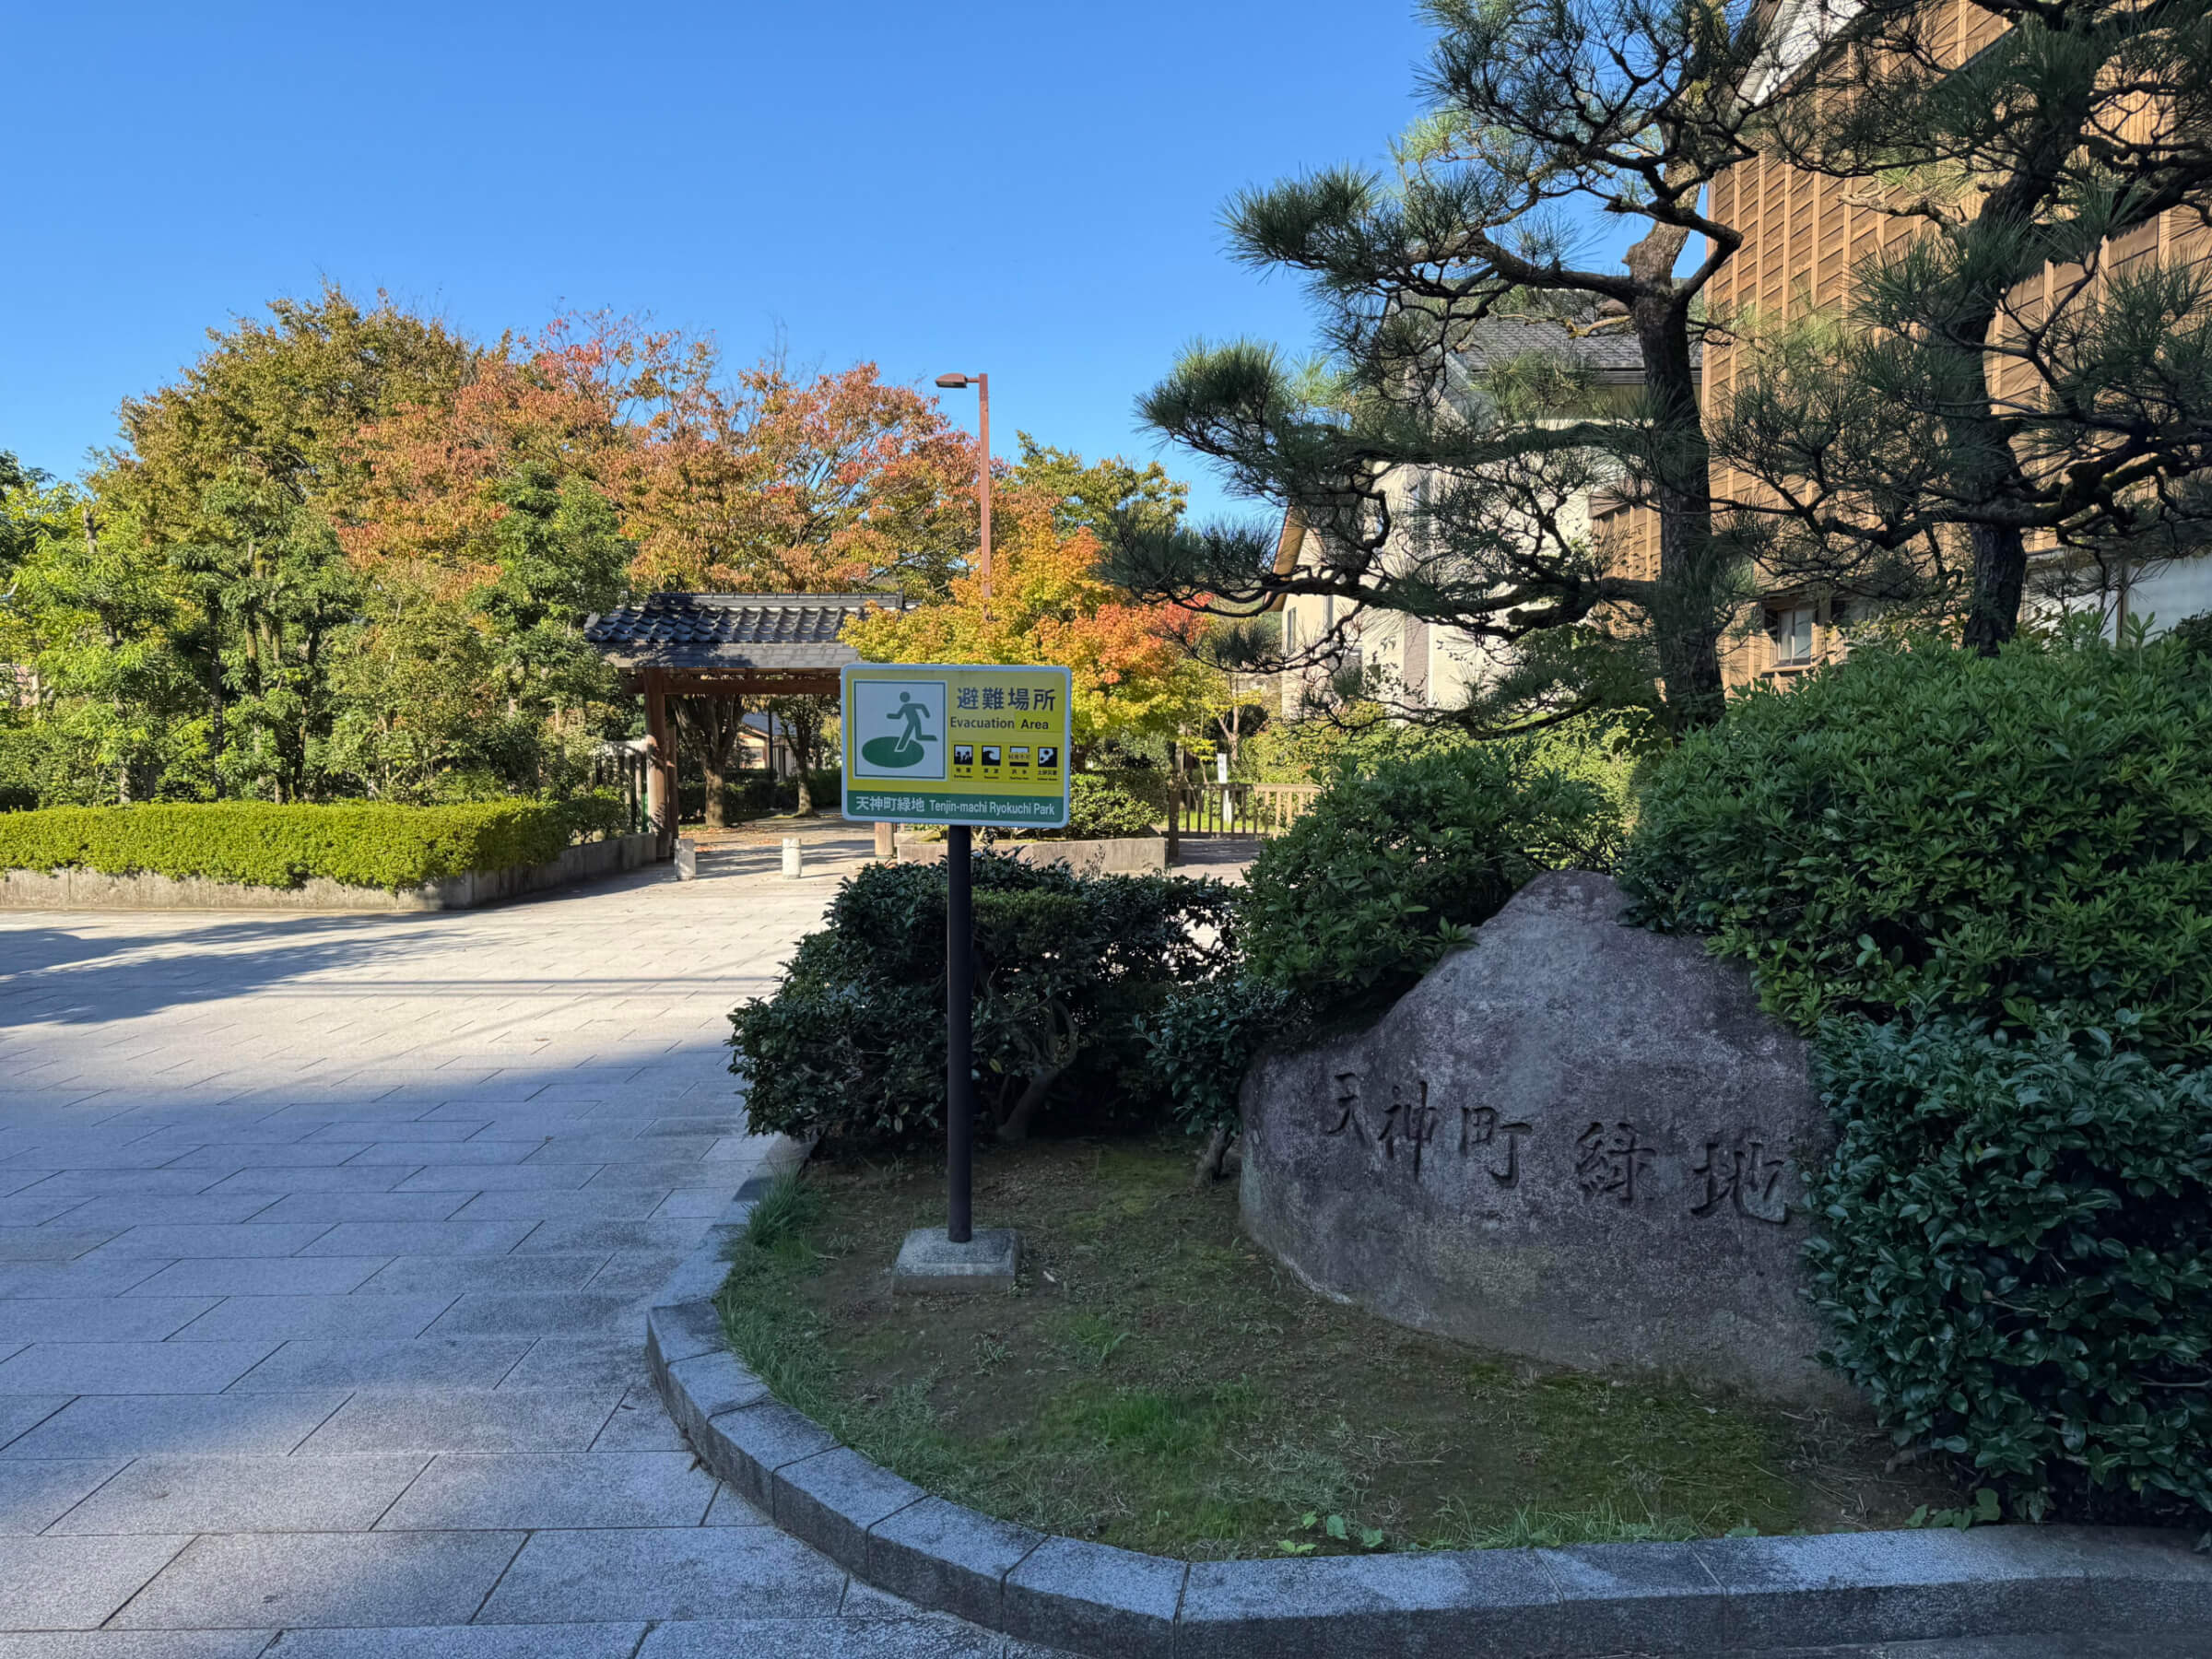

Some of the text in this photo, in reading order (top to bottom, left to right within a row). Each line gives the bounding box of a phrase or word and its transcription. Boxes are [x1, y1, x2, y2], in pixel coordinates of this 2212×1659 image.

[957, 688, 1055, 712] 避難場所
[950, 716, 1049, 730] Evacuation Area
[855, 795, 925, 812] 天神町緑地
[929, 799, 1055, 817] Tenjin-machi Ryokuchi Park
